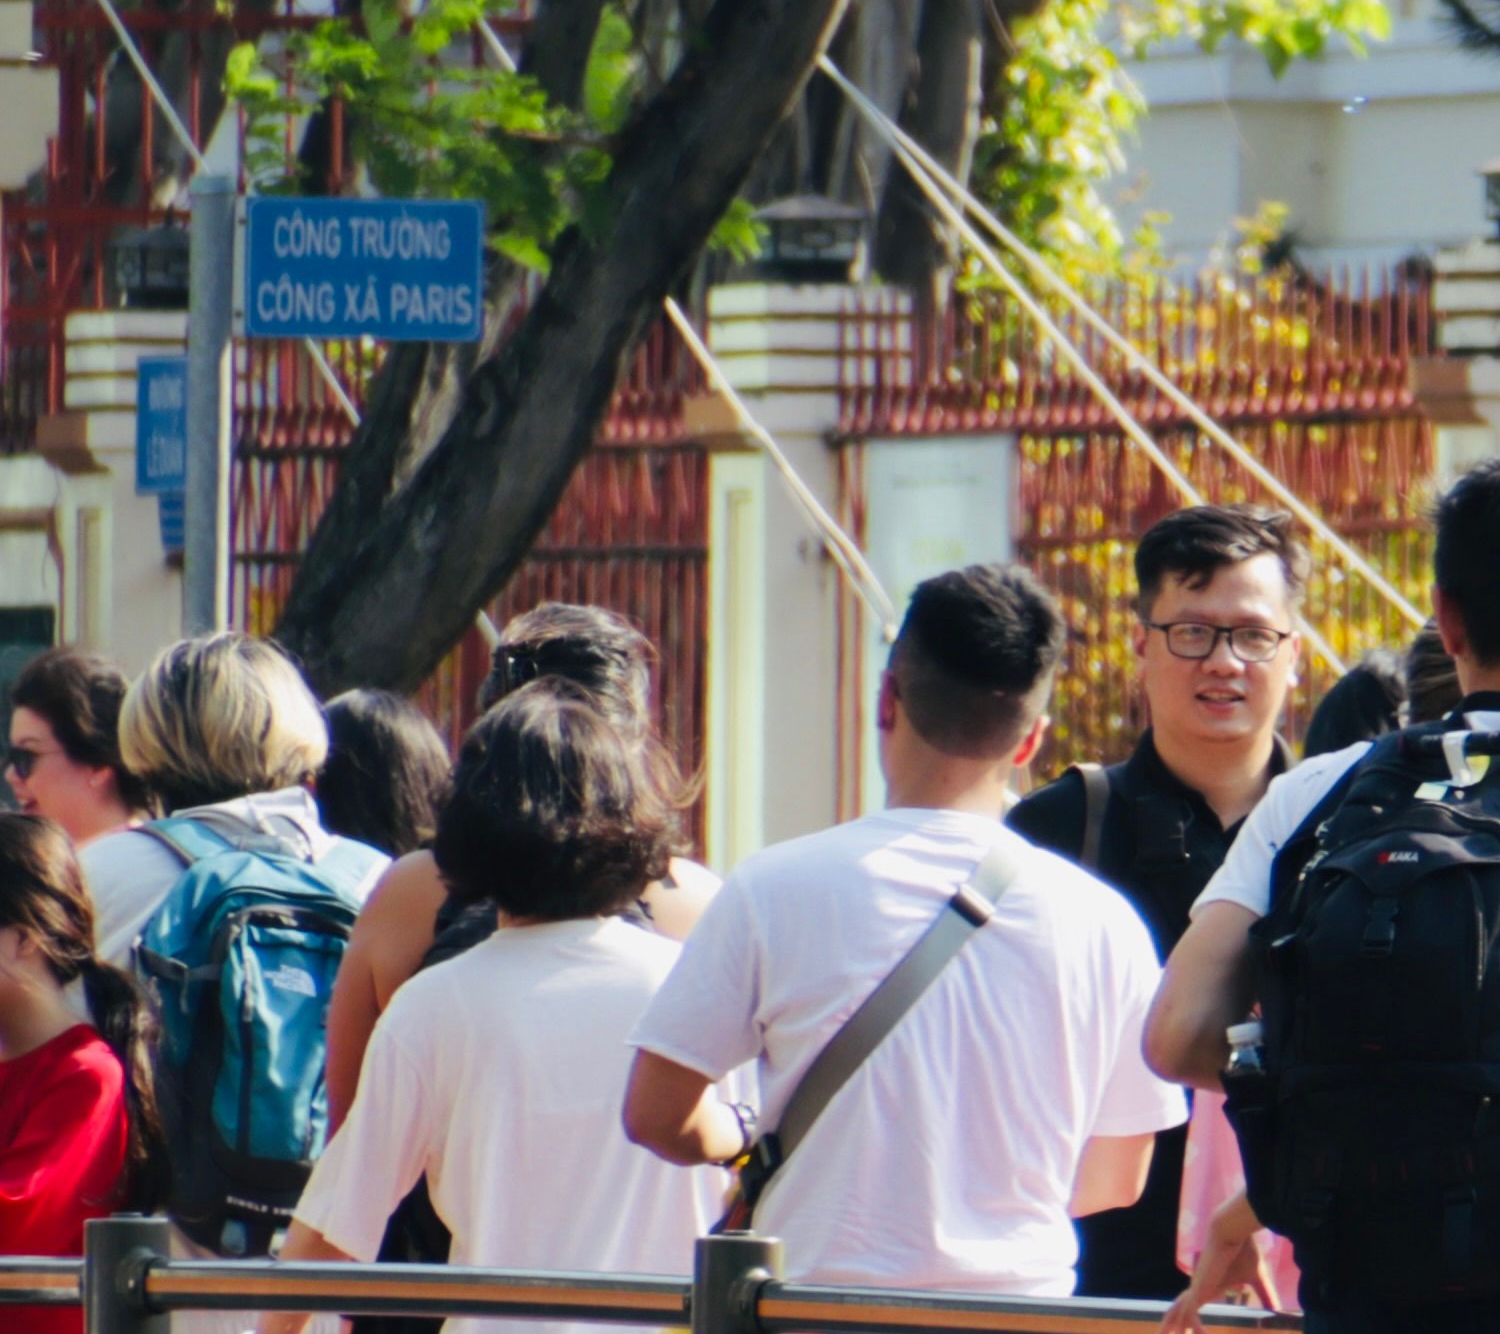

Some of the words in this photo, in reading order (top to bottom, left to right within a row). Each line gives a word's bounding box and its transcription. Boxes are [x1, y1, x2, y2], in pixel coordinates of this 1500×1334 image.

[273, 208, 342, 260] CÔNG
[348, 206, 452, 261] TRƯỜNG
[256, 272, 336, 323] CÔNG
[344, 274, 381, 323] XÃ
[390, 282, 474, 325] PARIS
